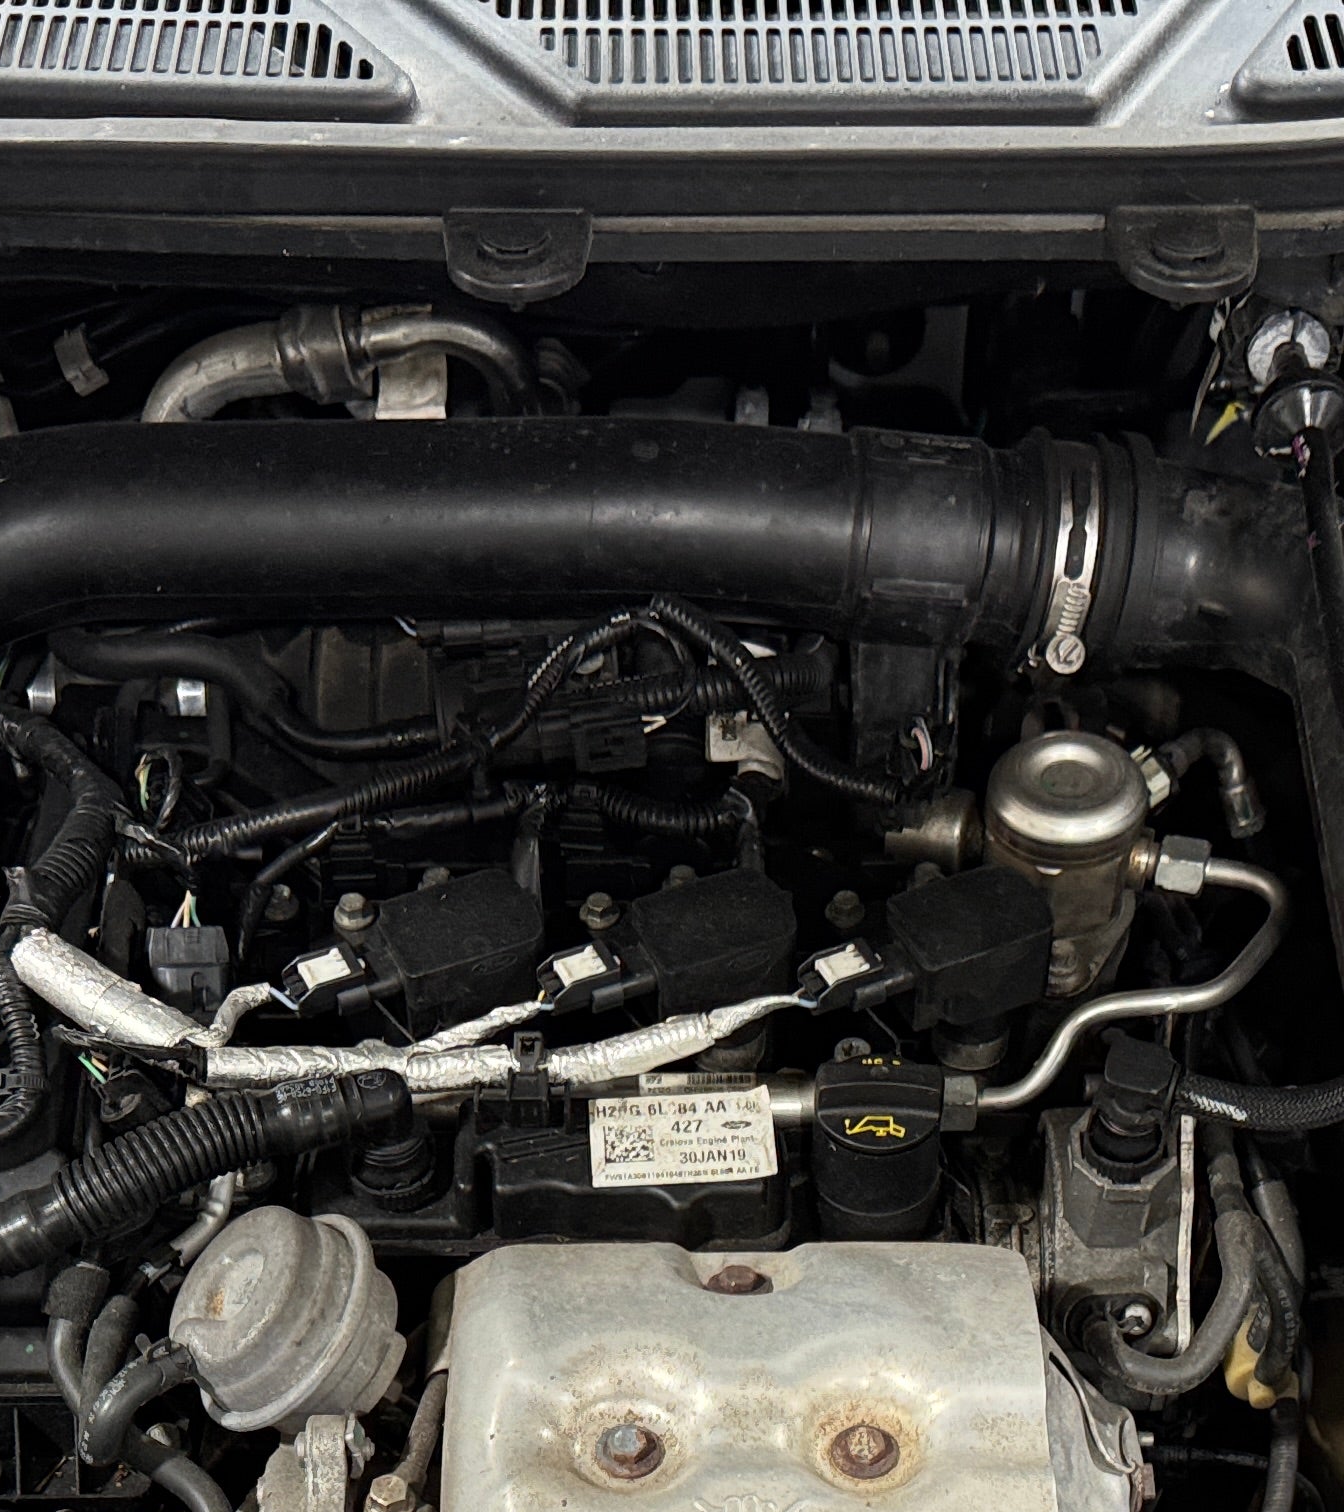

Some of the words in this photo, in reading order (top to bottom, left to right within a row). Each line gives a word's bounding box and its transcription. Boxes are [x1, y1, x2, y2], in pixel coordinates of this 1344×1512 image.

[704, 1100, 727, 1113] AA
[671, 1119, 703, 1133] 427
[697, 1135, 728, 1145] Engine
[731, 1134, 755, 1143] Plant
